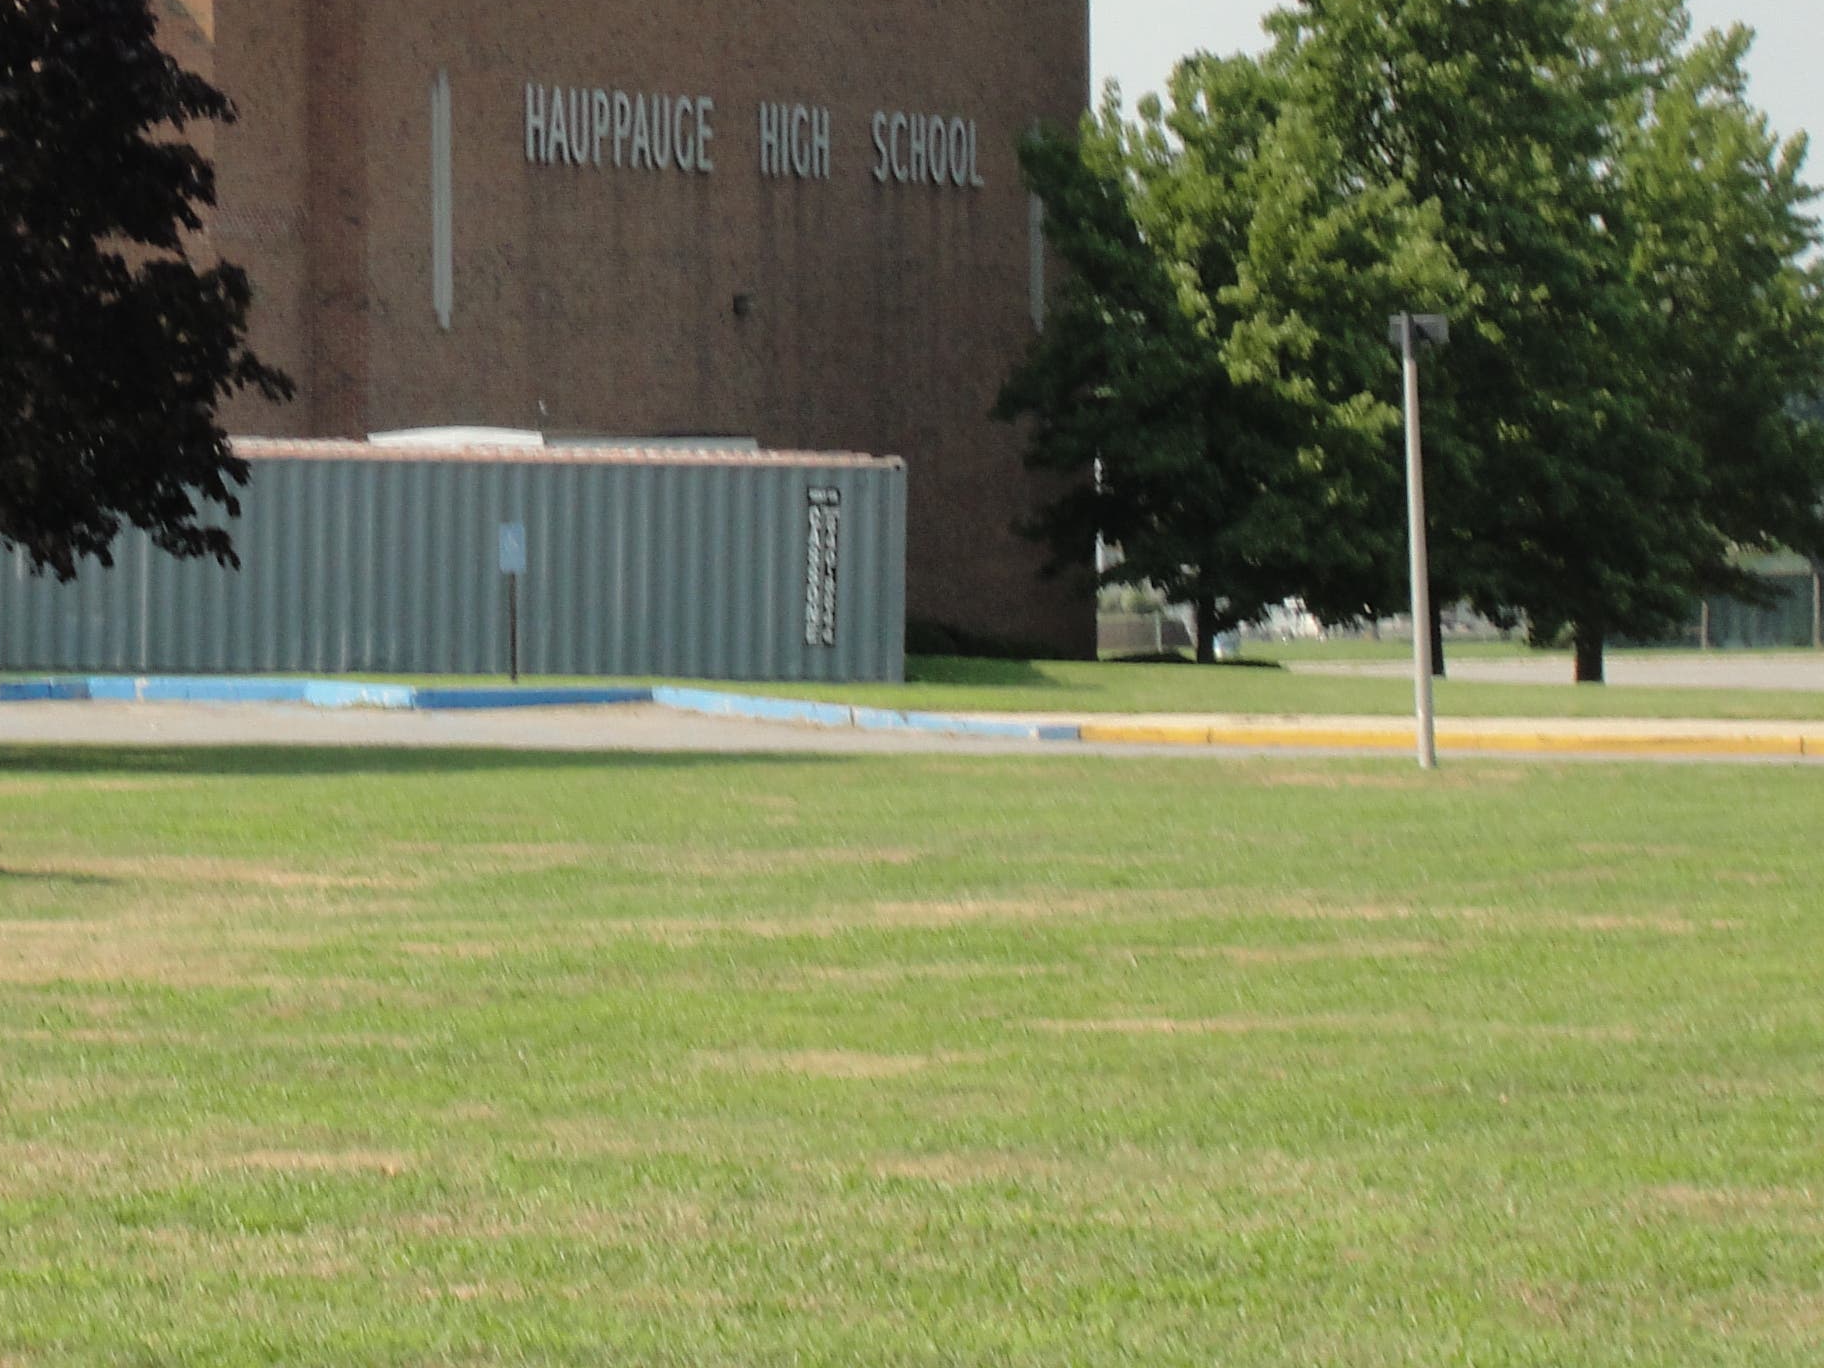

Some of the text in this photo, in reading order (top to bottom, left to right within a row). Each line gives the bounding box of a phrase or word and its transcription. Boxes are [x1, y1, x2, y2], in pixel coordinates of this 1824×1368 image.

[524, 82, 984, 187] HAUPPAUGE HIGH SCHOOL
